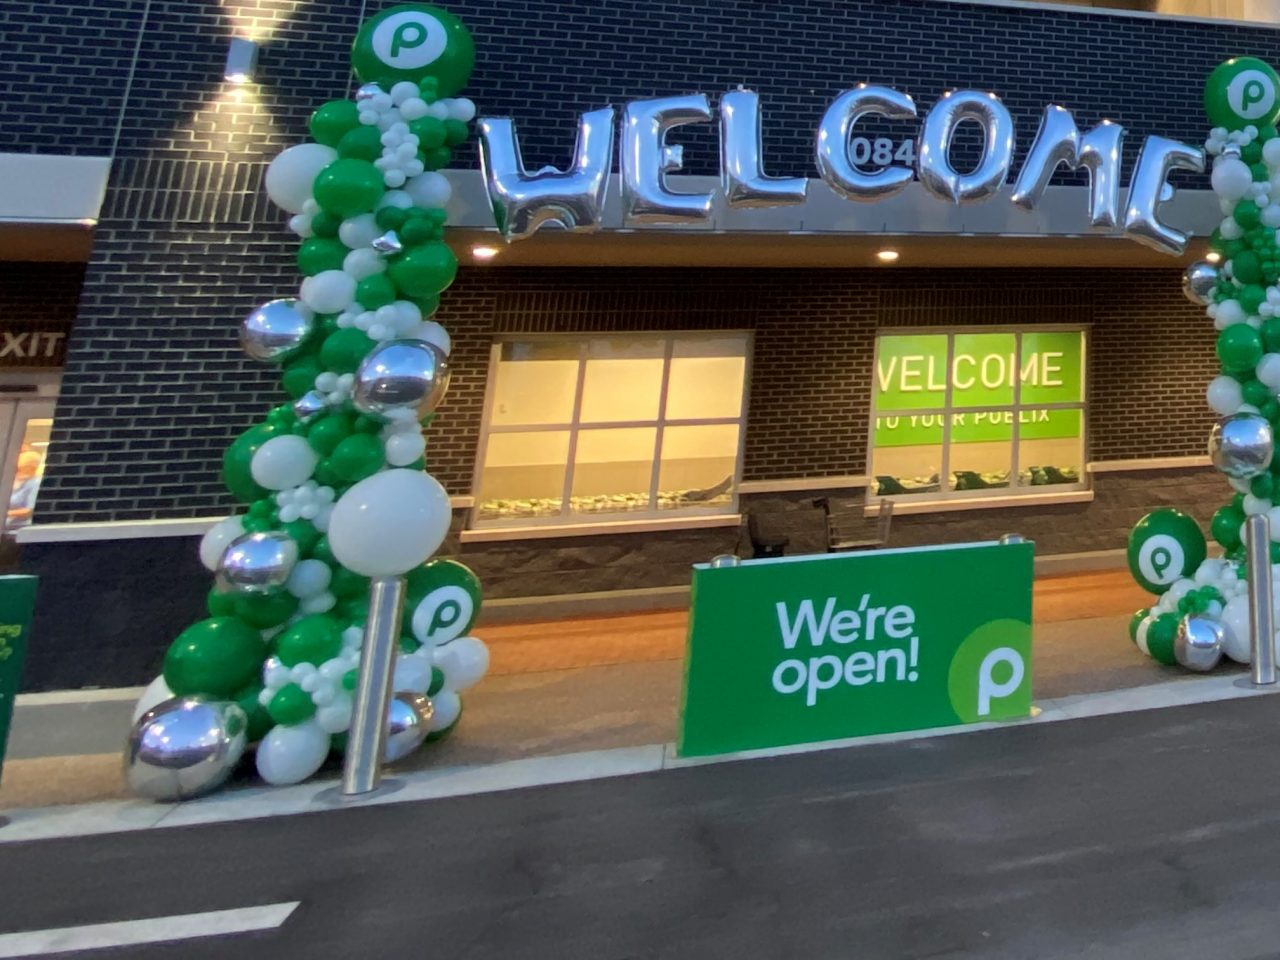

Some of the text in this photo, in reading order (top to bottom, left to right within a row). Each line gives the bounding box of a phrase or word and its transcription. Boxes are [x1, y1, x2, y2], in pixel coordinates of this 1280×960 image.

[477, 84, 1206, 257] WELCOME
[775, 593, 916, 650] We're
[771, 636, 919, 707] open!
